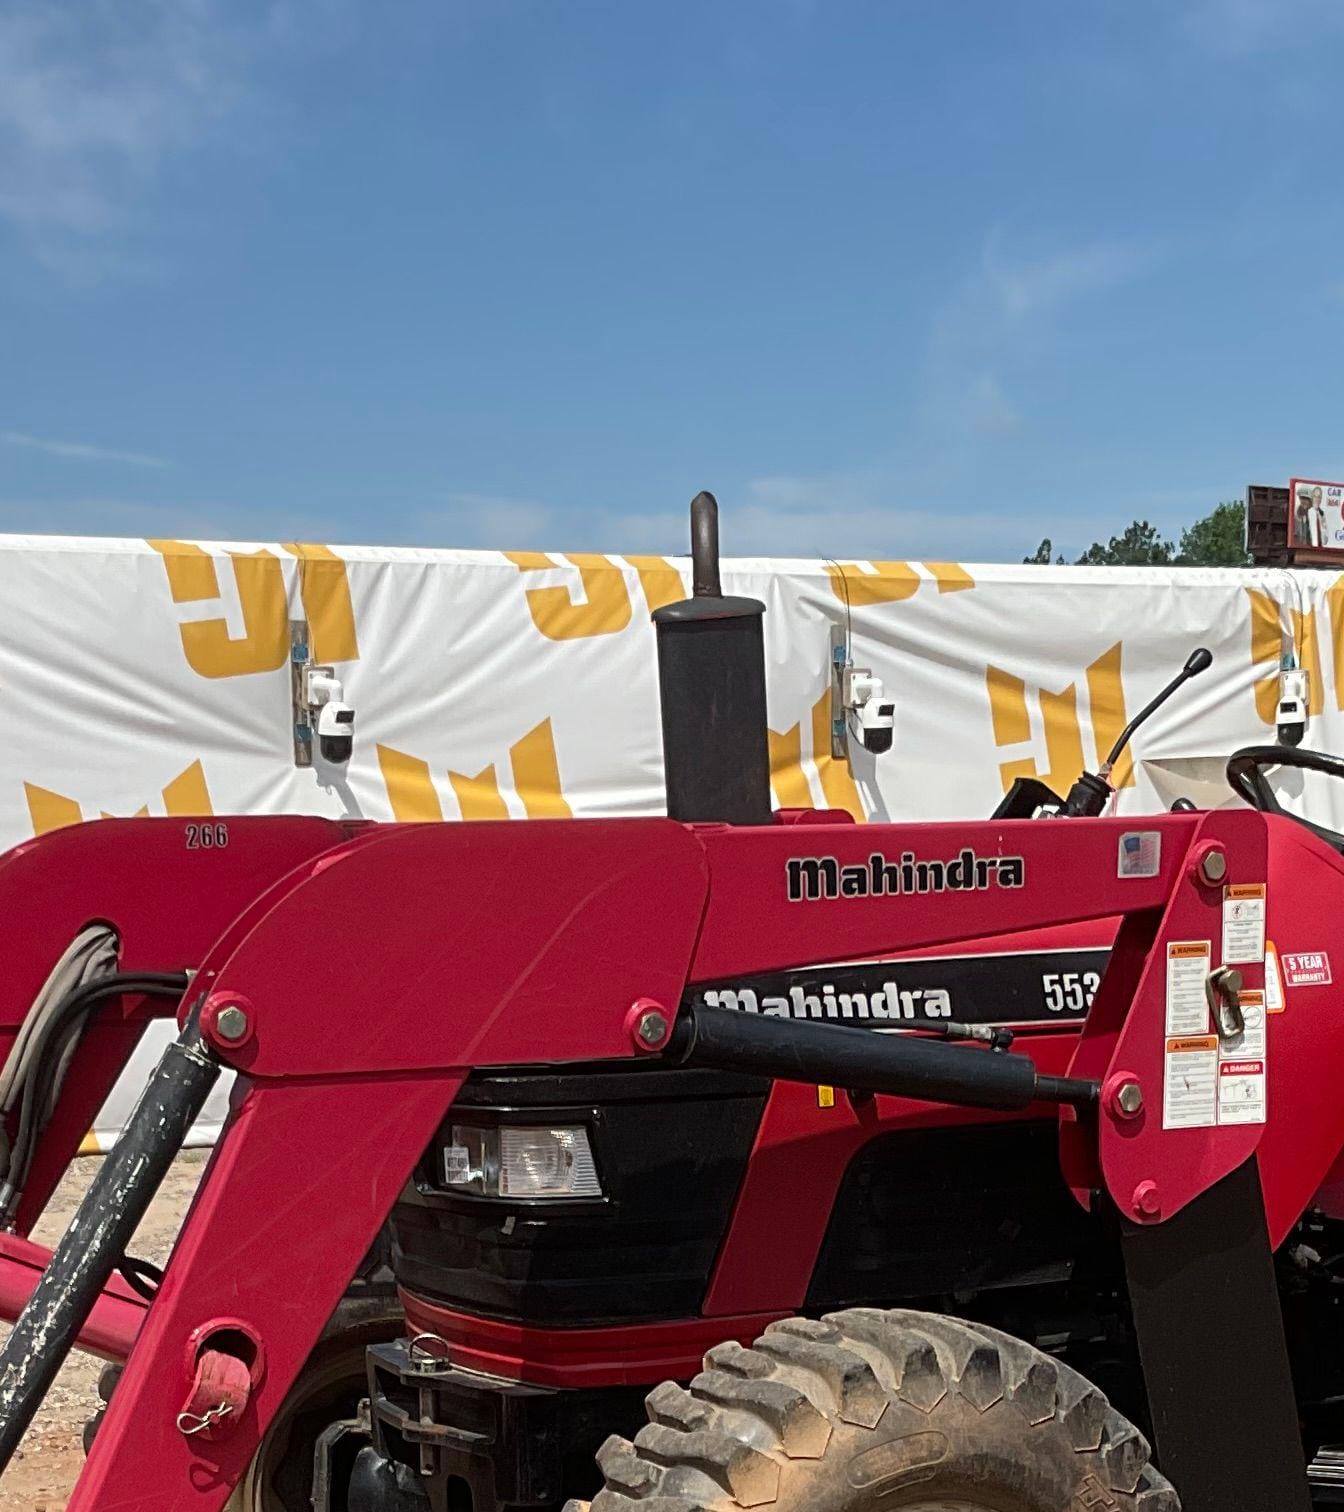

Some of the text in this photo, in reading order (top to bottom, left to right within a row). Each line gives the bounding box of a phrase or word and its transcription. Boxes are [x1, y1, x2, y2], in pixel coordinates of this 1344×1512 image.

[1327, 488, 1341, 497] CAR
[185, 824, 228, 849] 266
[786, 848, 1025, 901] Mahindra
[1233, 889, 1262, 897] WARNING
[1177, 945, 1206, 954] WARNING
[1288, 955, 1324, 971] 5 YEAR
[1292, 972, 1326, 983] WARRANTY
[703, 982, 952, 1019] Mahindra
[1181, 1040, 1209, 1048] WARNING
[1229, 1064, 1260, 1073] DANGER
